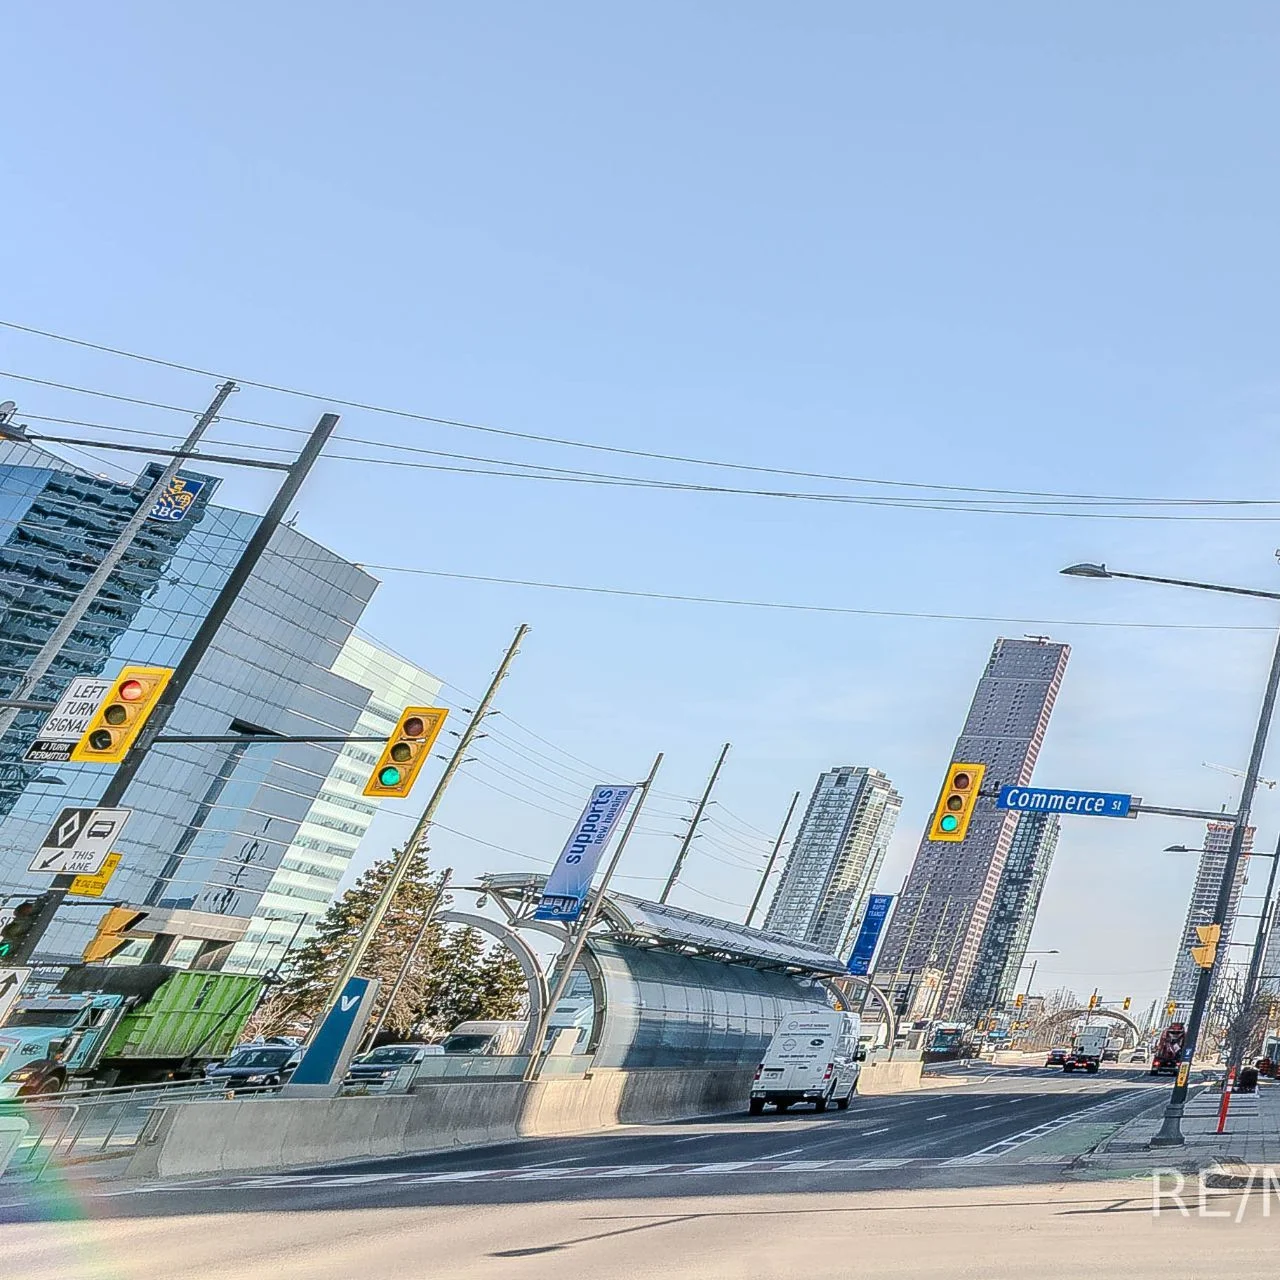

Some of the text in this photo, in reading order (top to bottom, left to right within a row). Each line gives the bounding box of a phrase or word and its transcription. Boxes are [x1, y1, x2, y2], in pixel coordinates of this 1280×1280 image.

[73, 685, 109, 699] LEFT
[64, 701, 98, 715] TURN
[46, 717, 87, 733] SIGNAL
[49, 742, 70, 752] TURN
[28, 750, 70, 761] PERMITTED
[1006, 789, 1105, 812] Commerce
[594, 790, 628, 845] new housing
[565, 789, 613, 865] supports
[72, 850, 96, 860] THIS
[63, 862, 91, 871] LANE
